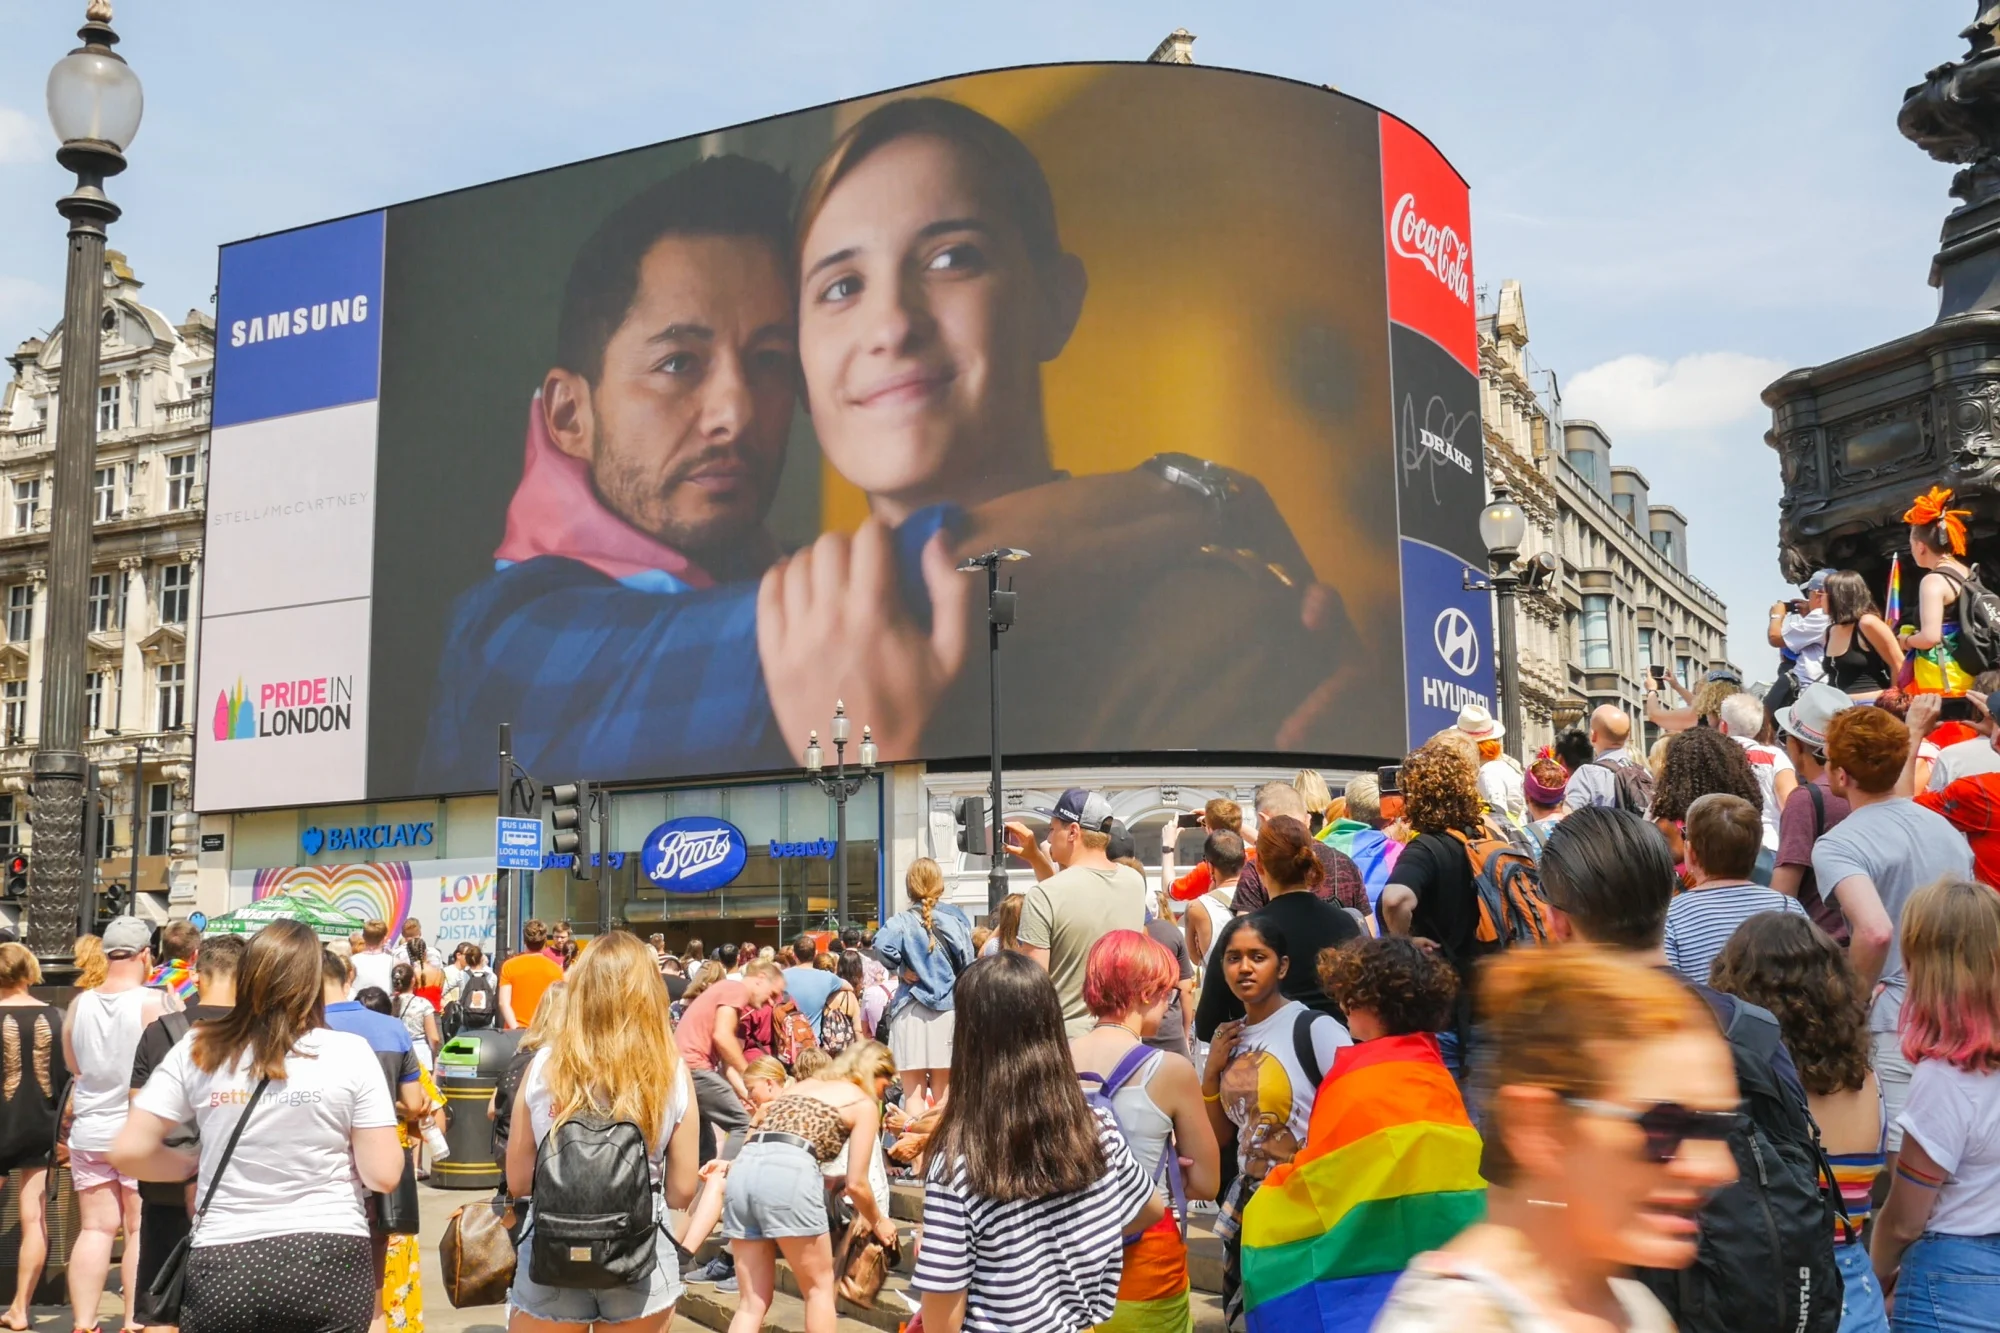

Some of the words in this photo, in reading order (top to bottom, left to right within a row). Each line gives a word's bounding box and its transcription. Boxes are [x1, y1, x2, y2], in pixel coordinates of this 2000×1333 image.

[231, 294, 368, 347] SAMSUNG
[1420, 428, 1474, 475] DRAKE
[260, 678, 327, 709] PRIDE
[330, 675, 352, 703] IN
[259, 703, 351, 737] LONDON
[327, 822, 434, 851] BARCLAYS
[502, 821, 517, 829] BUS
[519, 822, 537, 831] LANE
[499, 848, 518, 856] LOOK
[520, 849, 539, 857] BOTH
[650, 828, 731, 880] Boots
[769, 837, 838, 860] beauty
[509, 858, 529, 866] WAYS
[440, 905, 476, 921] GOES
[480, 904, 497, 919] TH
[439, 922, 497, 940] DISTANC
